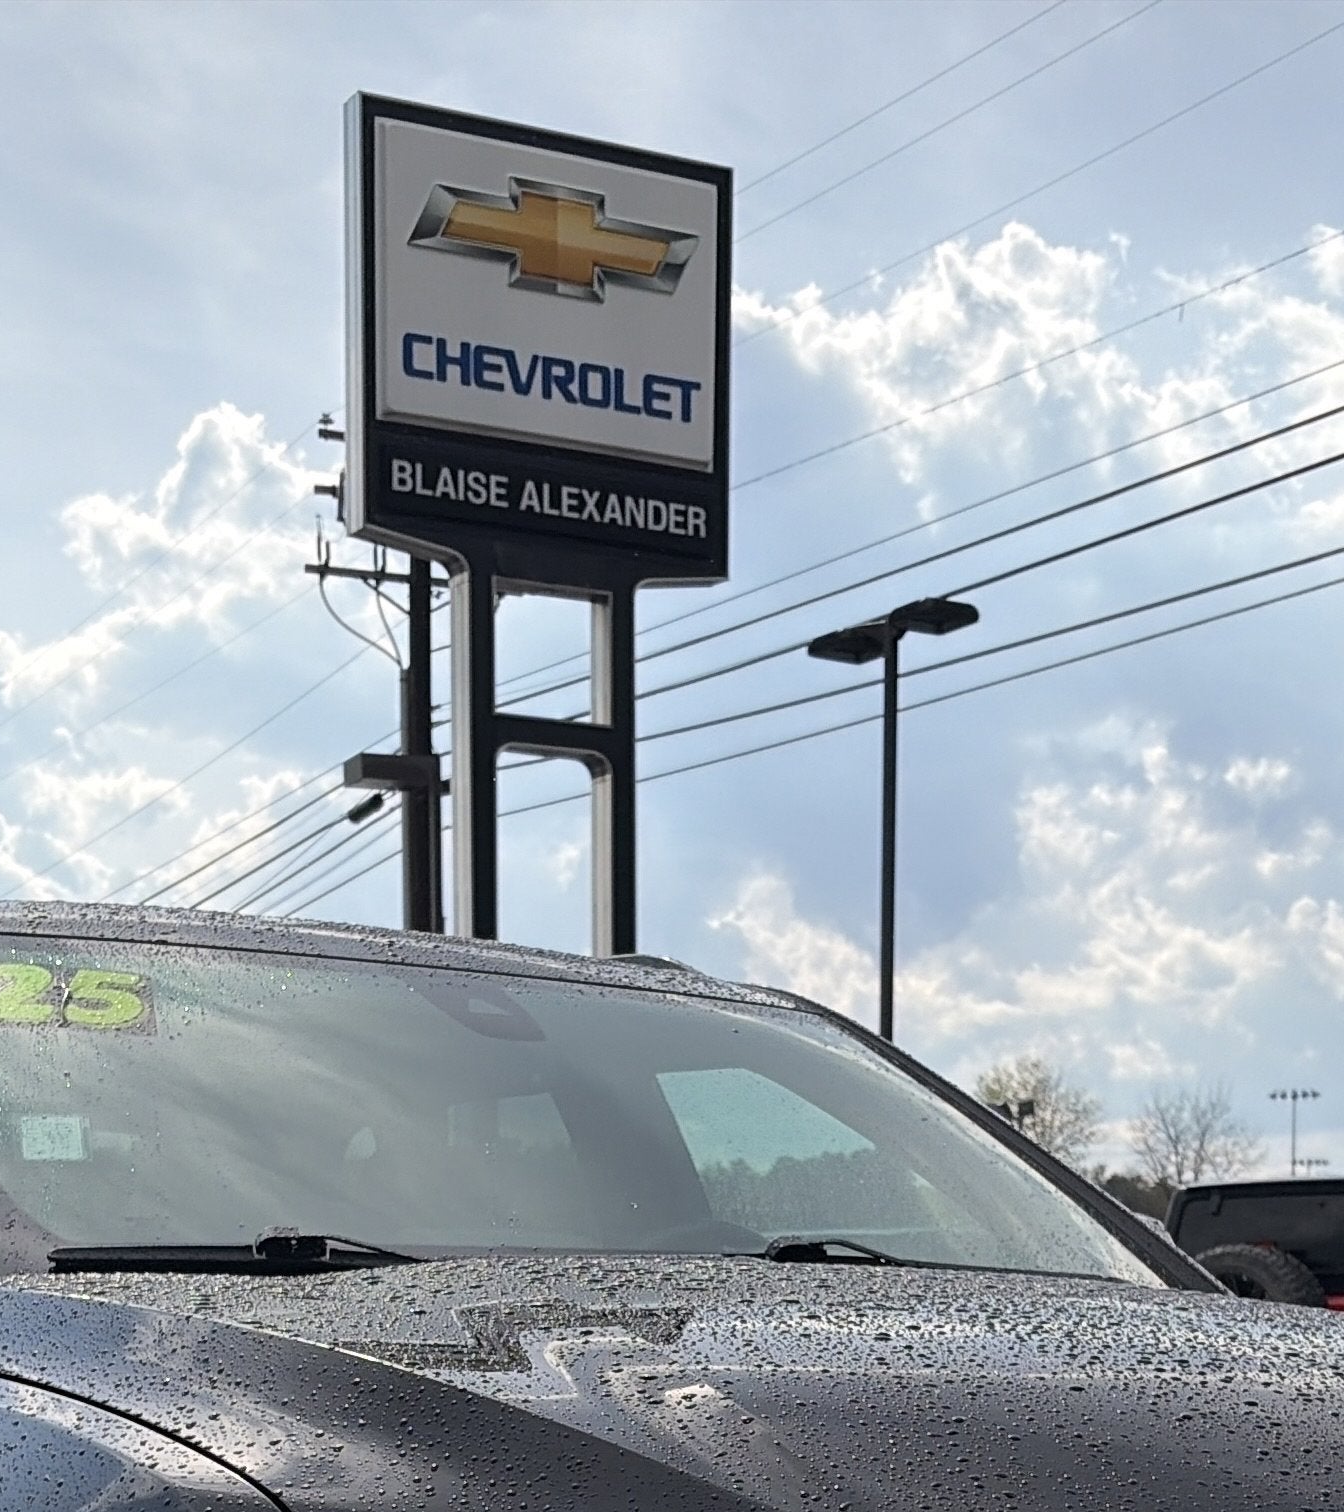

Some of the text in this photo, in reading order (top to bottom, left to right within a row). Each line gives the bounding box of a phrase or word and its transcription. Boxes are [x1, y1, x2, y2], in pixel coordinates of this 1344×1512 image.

[402, 332, 702, 423] CHEVROLET
[390, 458, 707, 538] BLAISE ALEXANDER
